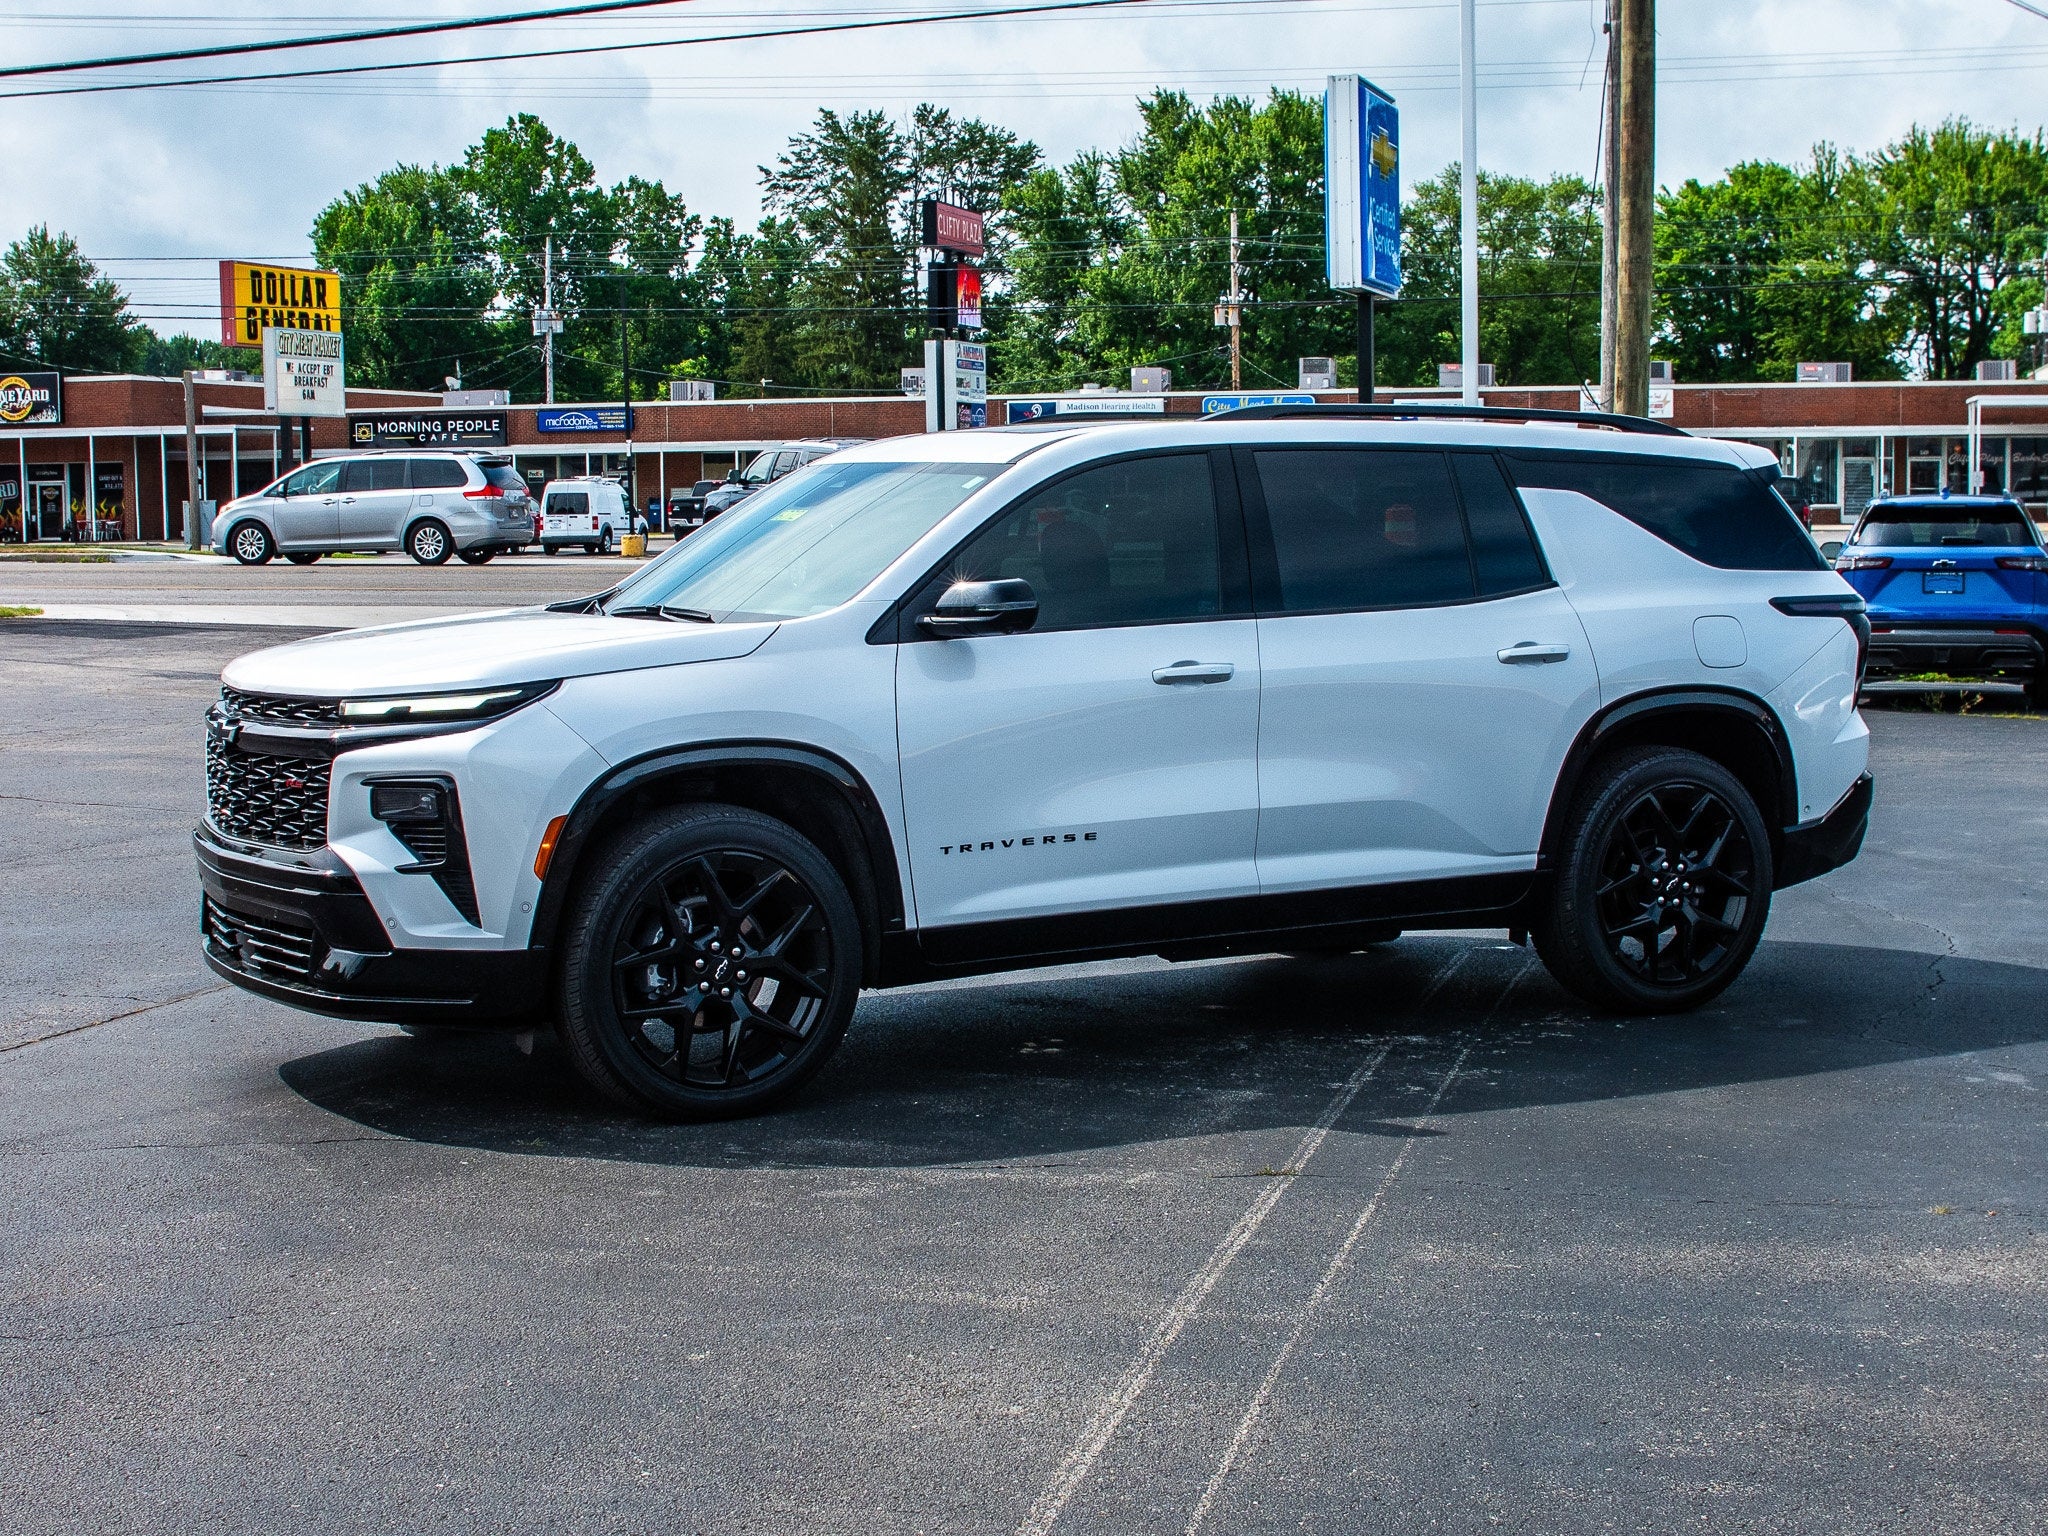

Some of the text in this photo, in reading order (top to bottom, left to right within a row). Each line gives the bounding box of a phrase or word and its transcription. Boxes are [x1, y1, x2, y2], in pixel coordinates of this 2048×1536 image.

[937, 213, 982, 245] CLIFTY PLAZA
[1374, 227, 1394, 257] Service
[250, 269, 327, 309] DOLLAR
[279, 331, 341, 358] CITY MEAT MARKET
[286, 362, 334, 376] WE ACCEPT EBT
[294, 376, 328, 388] BREAKFAST
[302, 389, 316, 400] 6AM
[1066, 402, 1156, 412] Madison Hearing Health
[377, 420, 500, 433] MORNING PEOPLE
[418, 433, 459, 442] CAFE
[939, 832, 1098, 855] TRAVERSE
